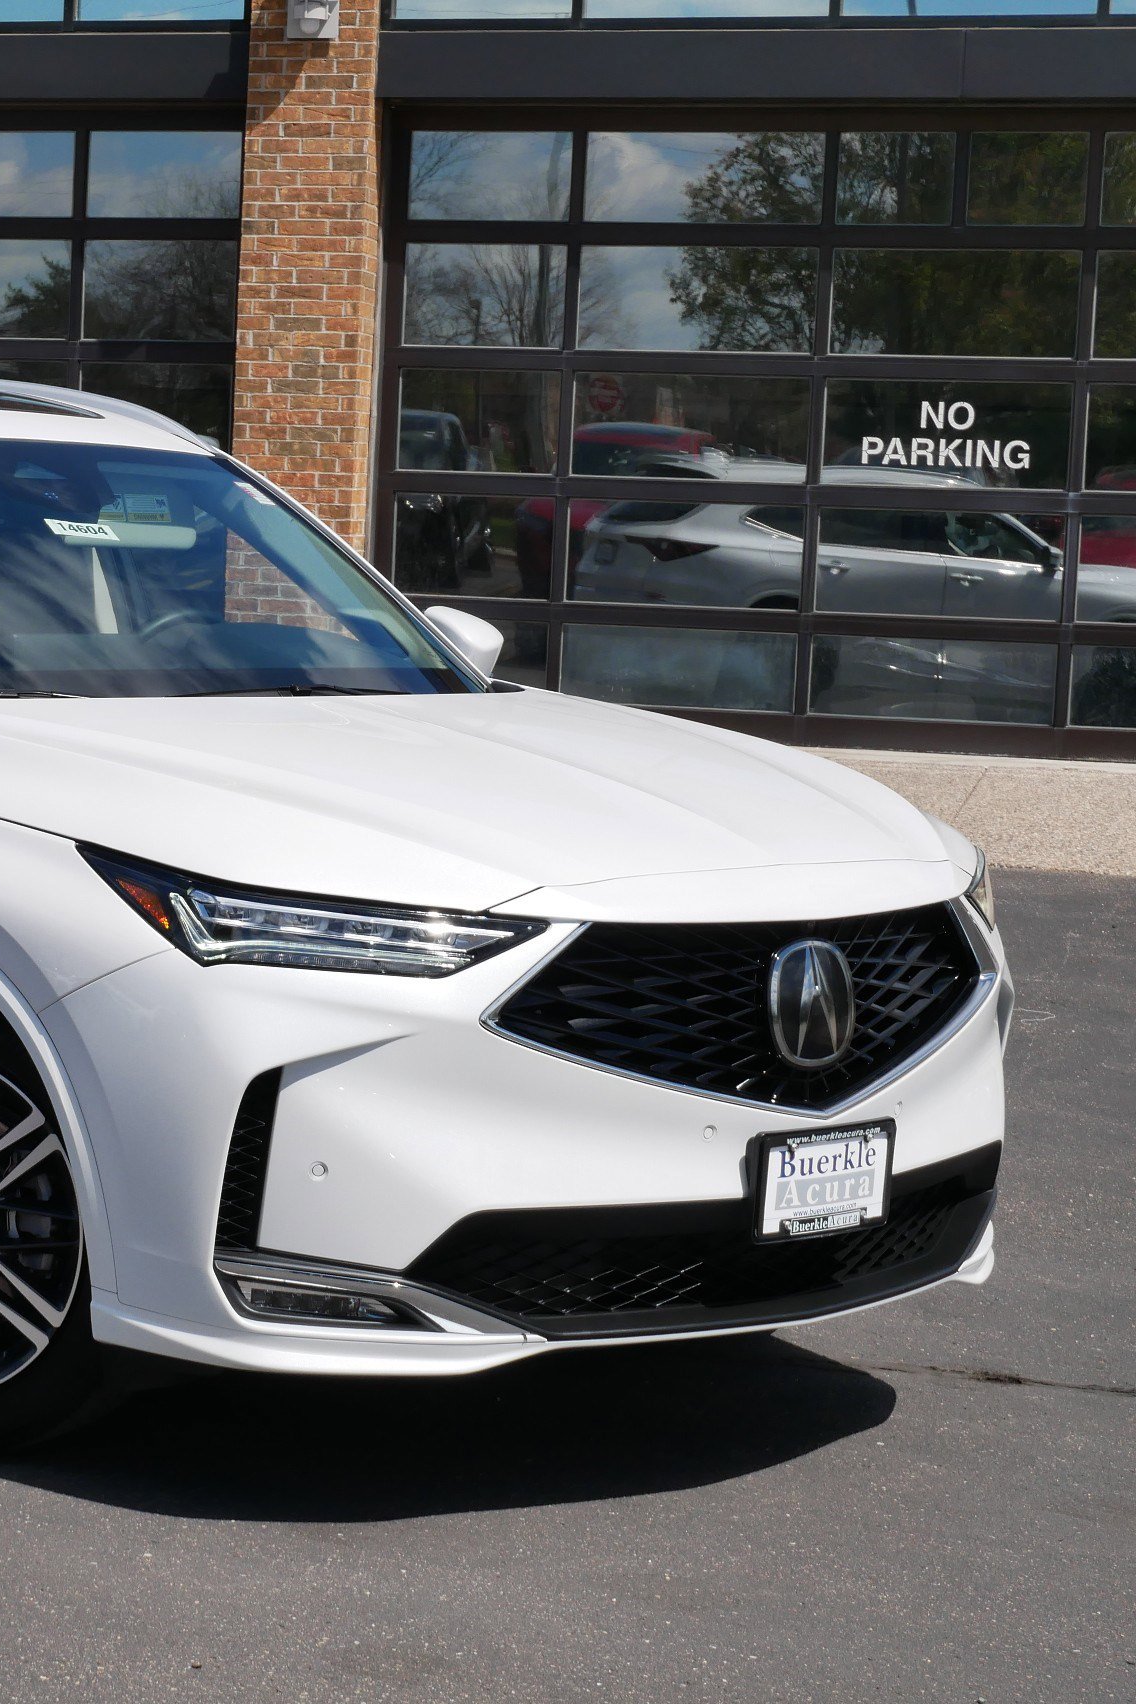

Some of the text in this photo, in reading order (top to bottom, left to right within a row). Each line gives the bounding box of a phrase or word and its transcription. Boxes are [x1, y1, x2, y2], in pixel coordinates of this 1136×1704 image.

[920, 400, 975, 430] NO
[861, 436, 1031, 469] PARKING
[57, 522, 108, 536] 14604
[786, 1126, 881, 1145] www.buerkleacura.com
[777, 1141, 876, 1178] Buerkle
[779, 1175, 870, 1208] Acura
[792, 1202, 857, 1217] www.buerkleacura.com
